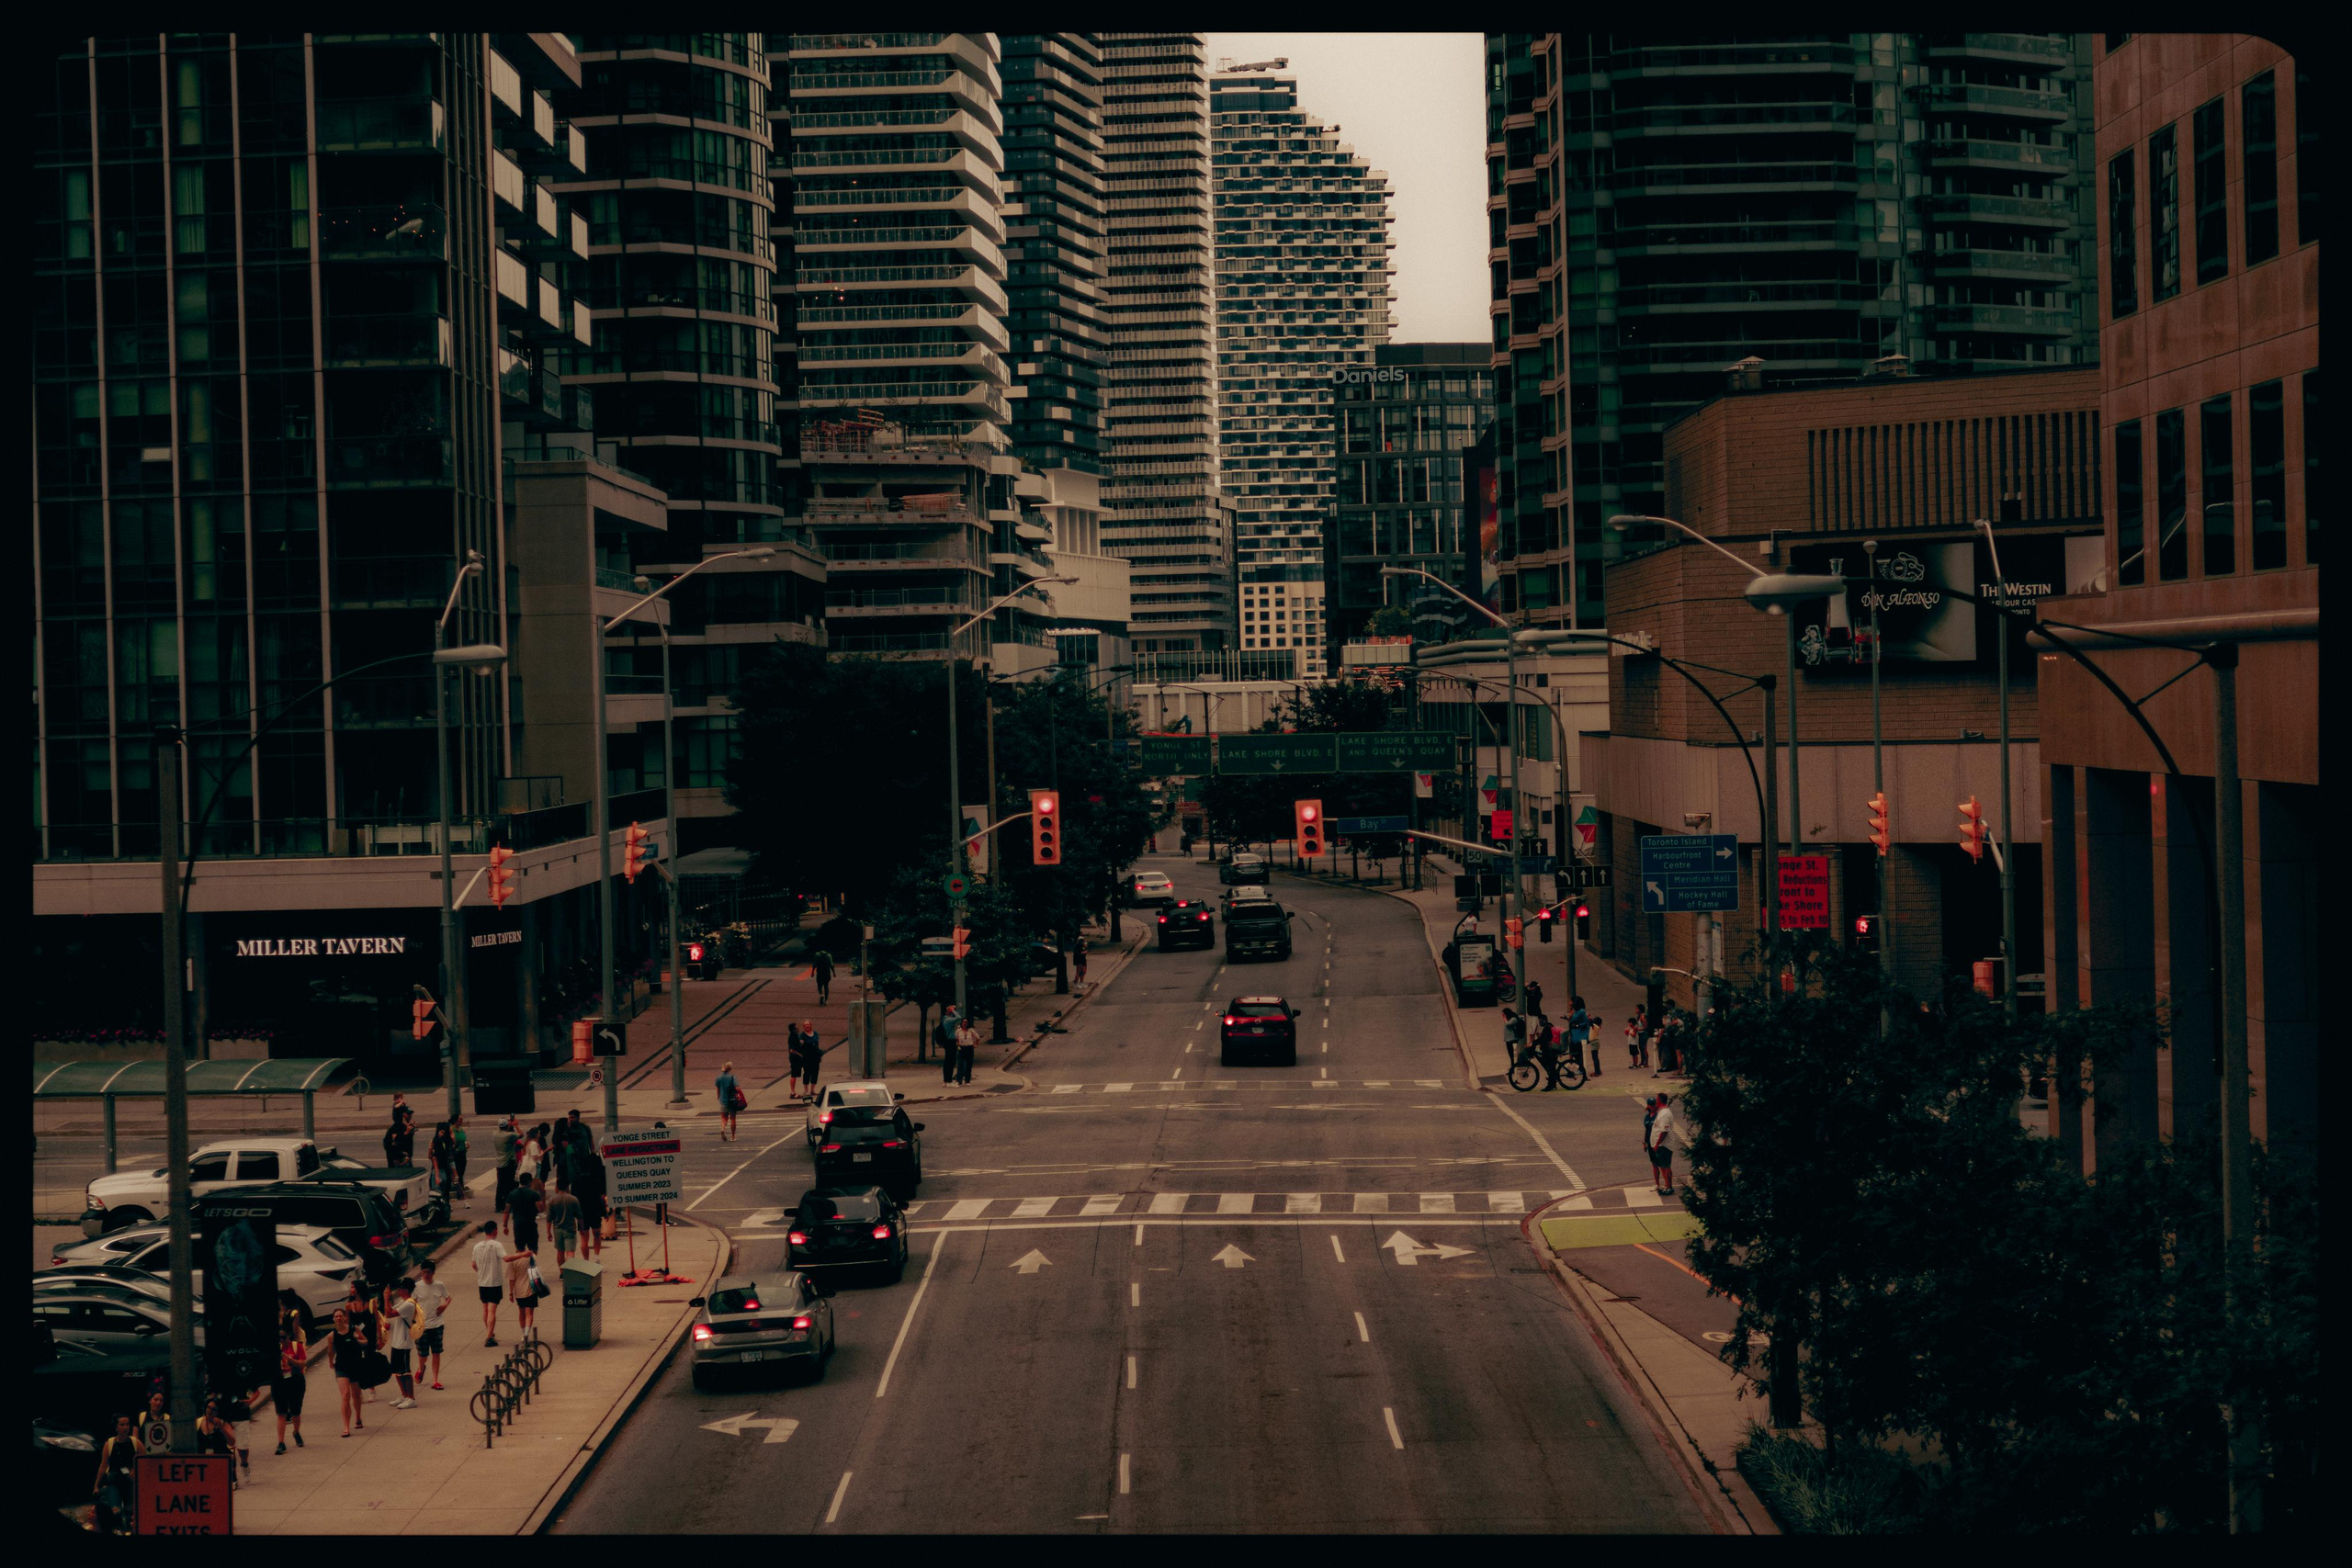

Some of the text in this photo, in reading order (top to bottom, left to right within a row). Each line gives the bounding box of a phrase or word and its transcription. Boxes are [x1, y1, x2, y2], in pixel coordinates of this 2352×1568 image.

[1332, 366, 1405, 384] Daniels
[1980, 582, 2052, 597] TH WESTIN
[1887, 588, 1940, 610] ALFONSO
[1341, 737, 1367, 746] LAKE
[1374, 737, 1408, 745] SHORE
[1414, 736, 1442, 744] BLVD.
[1222, 750, 1250, 759] LAKE
[1255, 750, 1290, 758] SHORE
[1295, 750, 1321, 758] BLVD.
[1420, 746, 1446, 755] QUAY
[1360, 819, 1378, 830] Bay
[1647, 838, 1679, 846] Toronto
[1468, 851, 1482, 861] 50
[1653, 851, 1702, 860] Harbourfront
[1674, 875, 1711, 884] Meridian
[1679, 889, 1727, 900] Hockey Hall
[1780, 887, 1815, 897] ront to
[1794, 901, 1823, 909] Shore
[470, 930, 522, 948] MILLER TAVERN
[236, 937, 406, 957] MILLER TAVERN
[612, 1131, 671, 1143] YONGE STREET
[606, 1143, 678, 1156] LANE REDUCTIONS
[612, 1157, 662, 1167] WELLINGTON
[616, 1168, 671, 1179] QUEENS QUAY
[617, 1180, 671, 1191] SUMMER 2023
[612, 1196, 623, 1204] TO
[625, 1194, 659, 1203] SUMMER
[232, 1208, 272, 1217] GO
[225, 1348, 259, 1356] WOLL
[158, 1465, 206, 1483] LEFT
[156, 1495, 211, 1513] LANE
